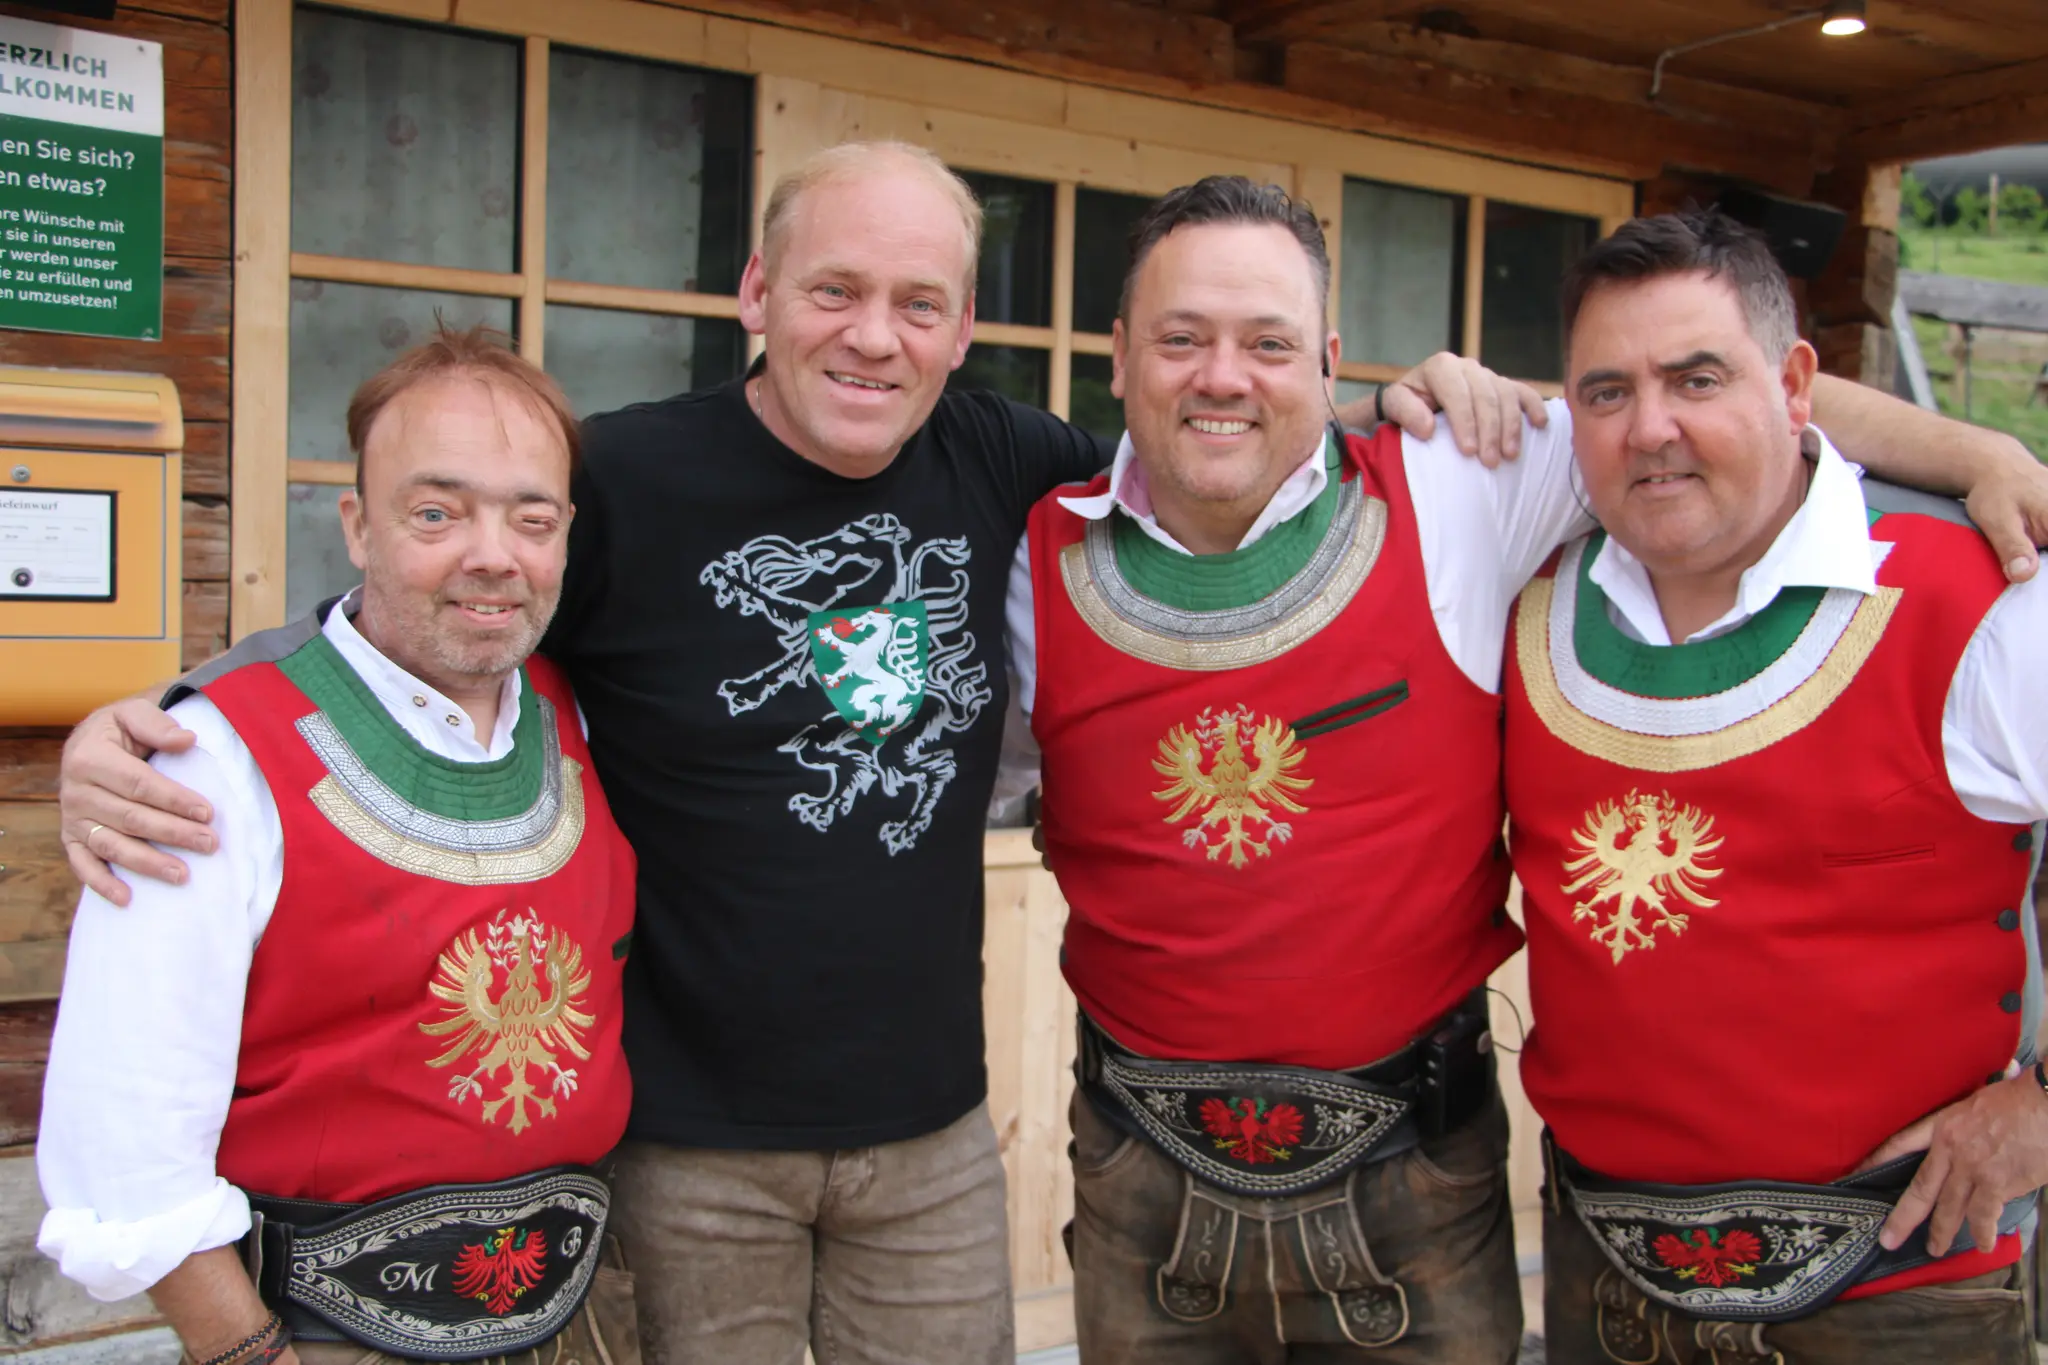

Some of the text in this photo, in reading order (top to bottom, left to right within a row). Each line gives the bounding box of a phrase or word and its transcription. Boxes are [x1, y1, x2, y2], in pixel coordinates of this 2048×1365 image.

[0, 73, 134, 114] LKOMMEN
[0, 139, 135, 171] en Sie sich?
[27, 173, 107, 197] etwas?
[23, 209, 96, 231] Wünsche
[100, 219, 125, 234] mit
[6, 228, 29, 242] sie
[33, 229, 48, 244] in
[52, 235, 116, 252] unseren
[9, 249, 70, 266] werden
[73, 256, 118, 271] unser
[16, 269, 34, 282] zu
[38, 270, 100, 289] erfüllen
[104, 278, 132, 292] und
[18, 289, 118, 310] umzusetzen!
[380, 1261, 440, 1293] M
